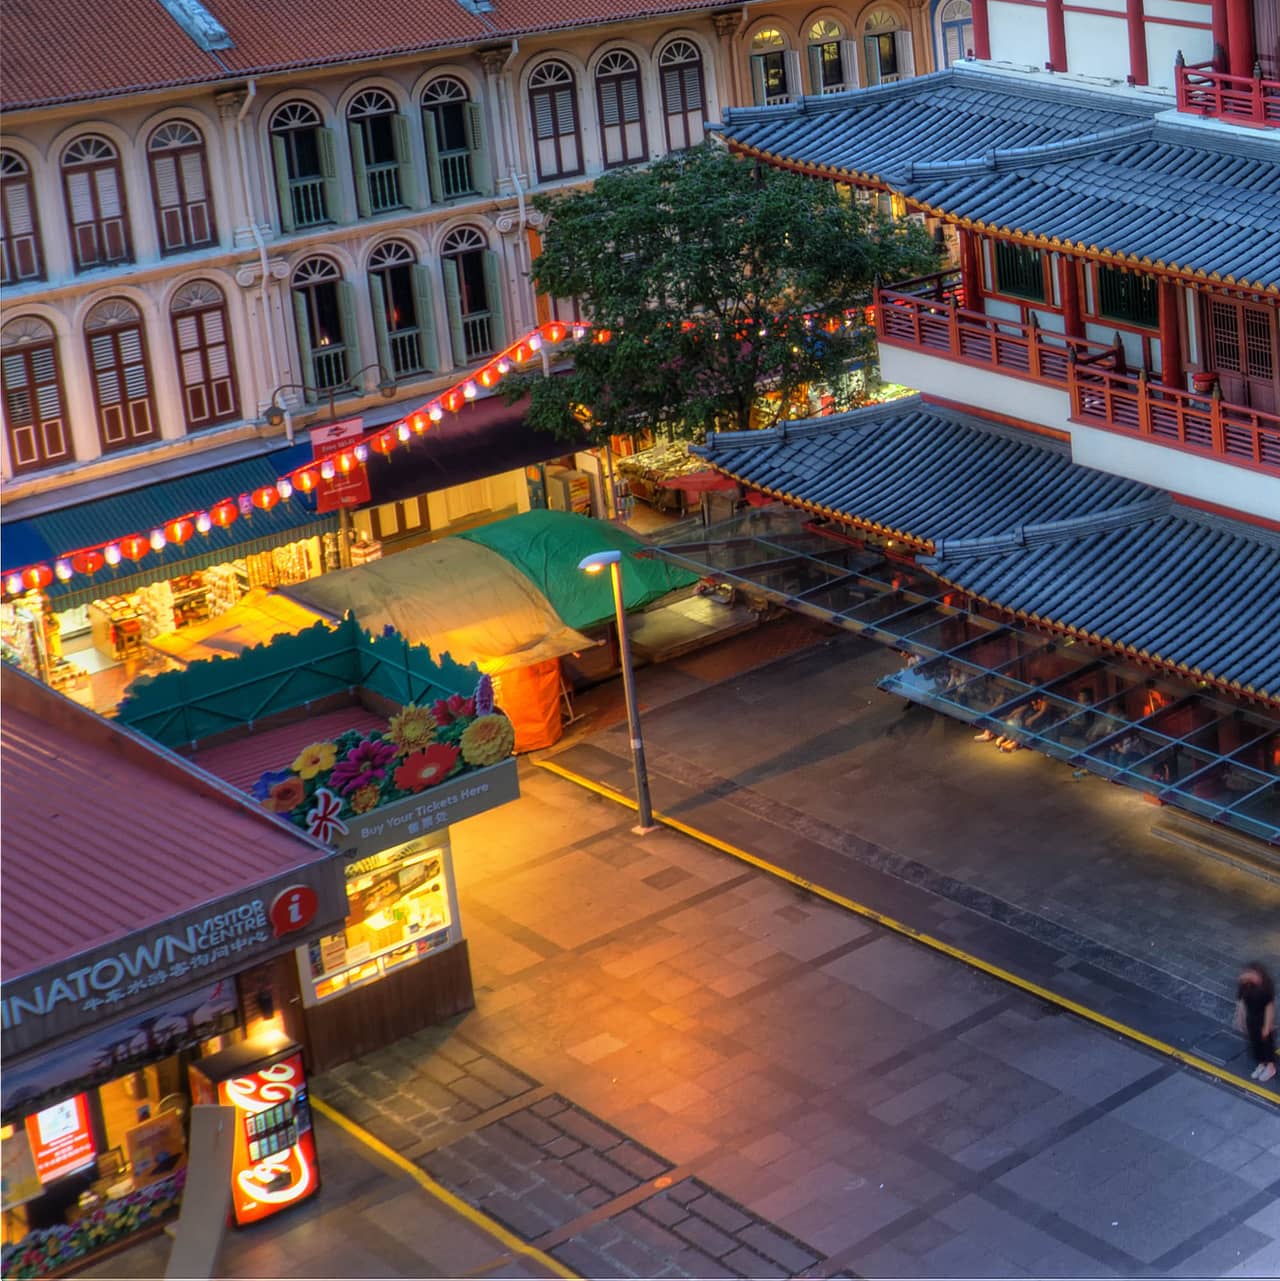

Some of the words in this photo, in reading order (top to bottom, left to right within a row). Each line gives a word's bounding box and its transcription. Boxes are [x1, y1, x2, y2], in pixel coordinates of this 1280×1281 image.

[360, 823, 384, 839] Buy
[386, 811, 414, 828] Your
[415, 795, 458, 818] Tickets
[460, 783, 489, 801] Here
[194, 899, 265, 934] VISITOR
[198, 914, 268, 950] CENTRE
